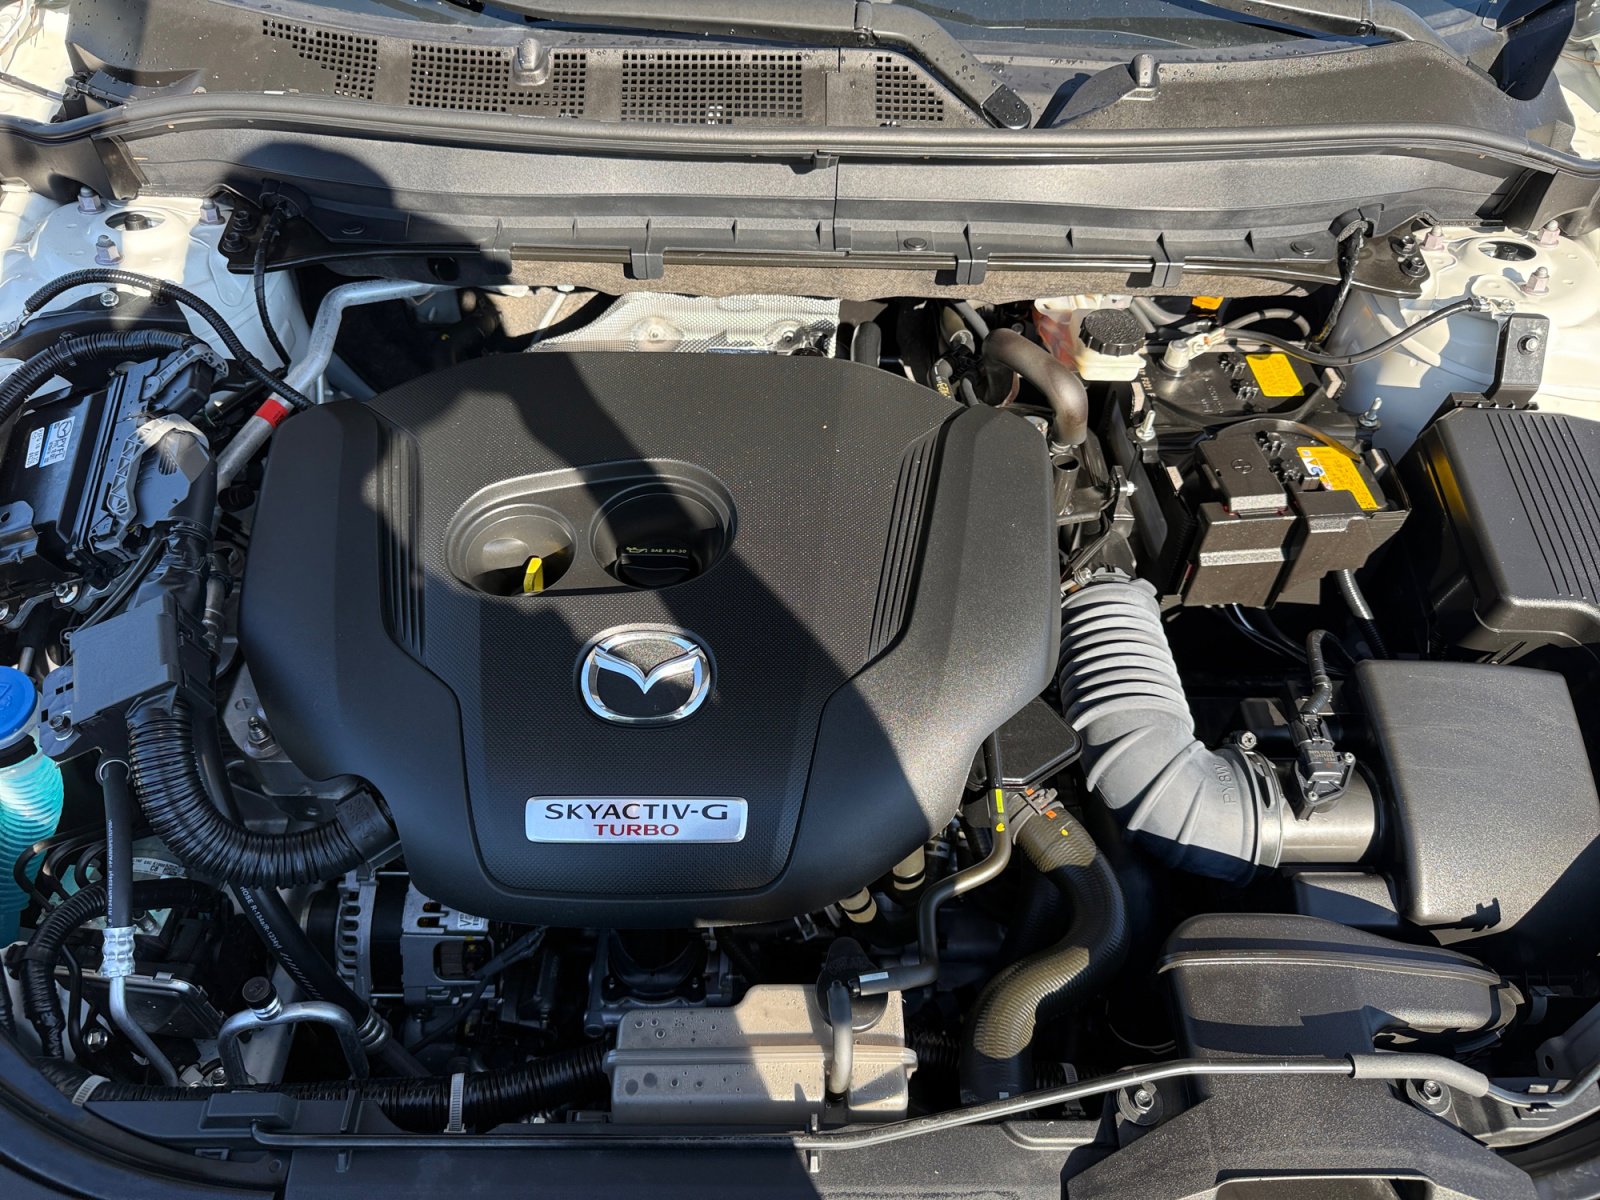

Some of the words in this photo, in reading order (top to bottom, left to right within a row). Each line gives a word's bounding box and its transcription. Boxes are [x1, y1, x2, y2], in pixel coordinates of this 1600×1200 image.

[1213, 763, 1236, 804] PY8W
[545, 803, 729, 820] SKYACTIV-G
[593, 824, 680, 836] TURBO
